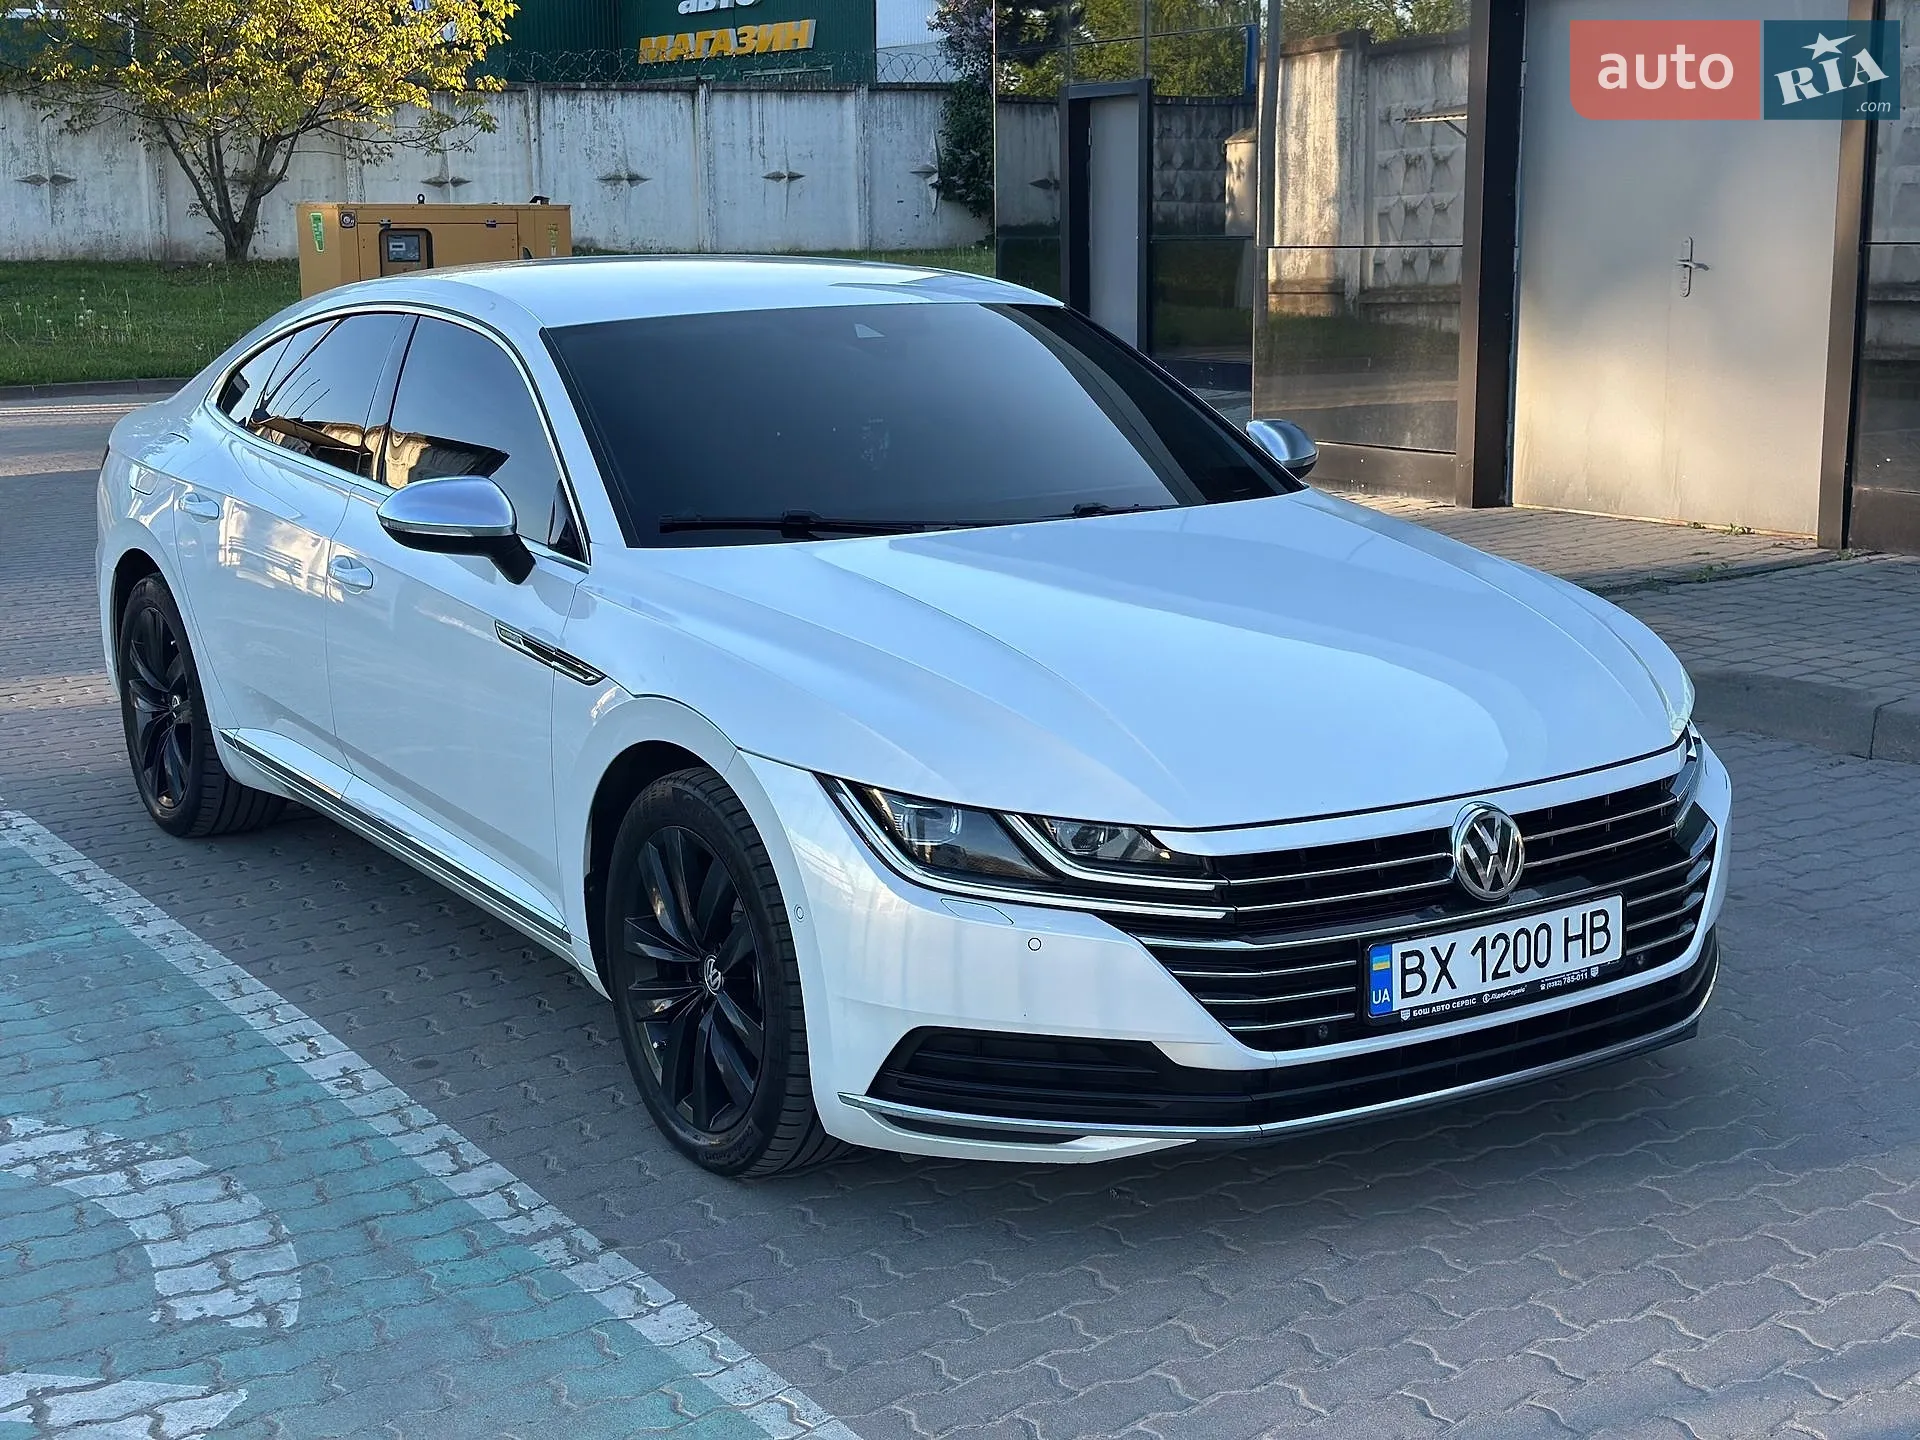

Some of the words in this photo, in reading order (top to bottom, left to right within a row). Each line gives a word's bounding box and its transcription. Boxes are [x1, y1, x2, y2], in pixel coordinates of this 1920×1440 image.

[638, 19, 816, 64] МАГАЗИН
[1400, 942, 1458, 1000] BX
[1470, 922, 1552, 984] 1200
[1562, 908, 1611, 963] HB
[1372, 988, 1391, 1005] UA
[1431, 1004, 1451, 1014] АВТО
